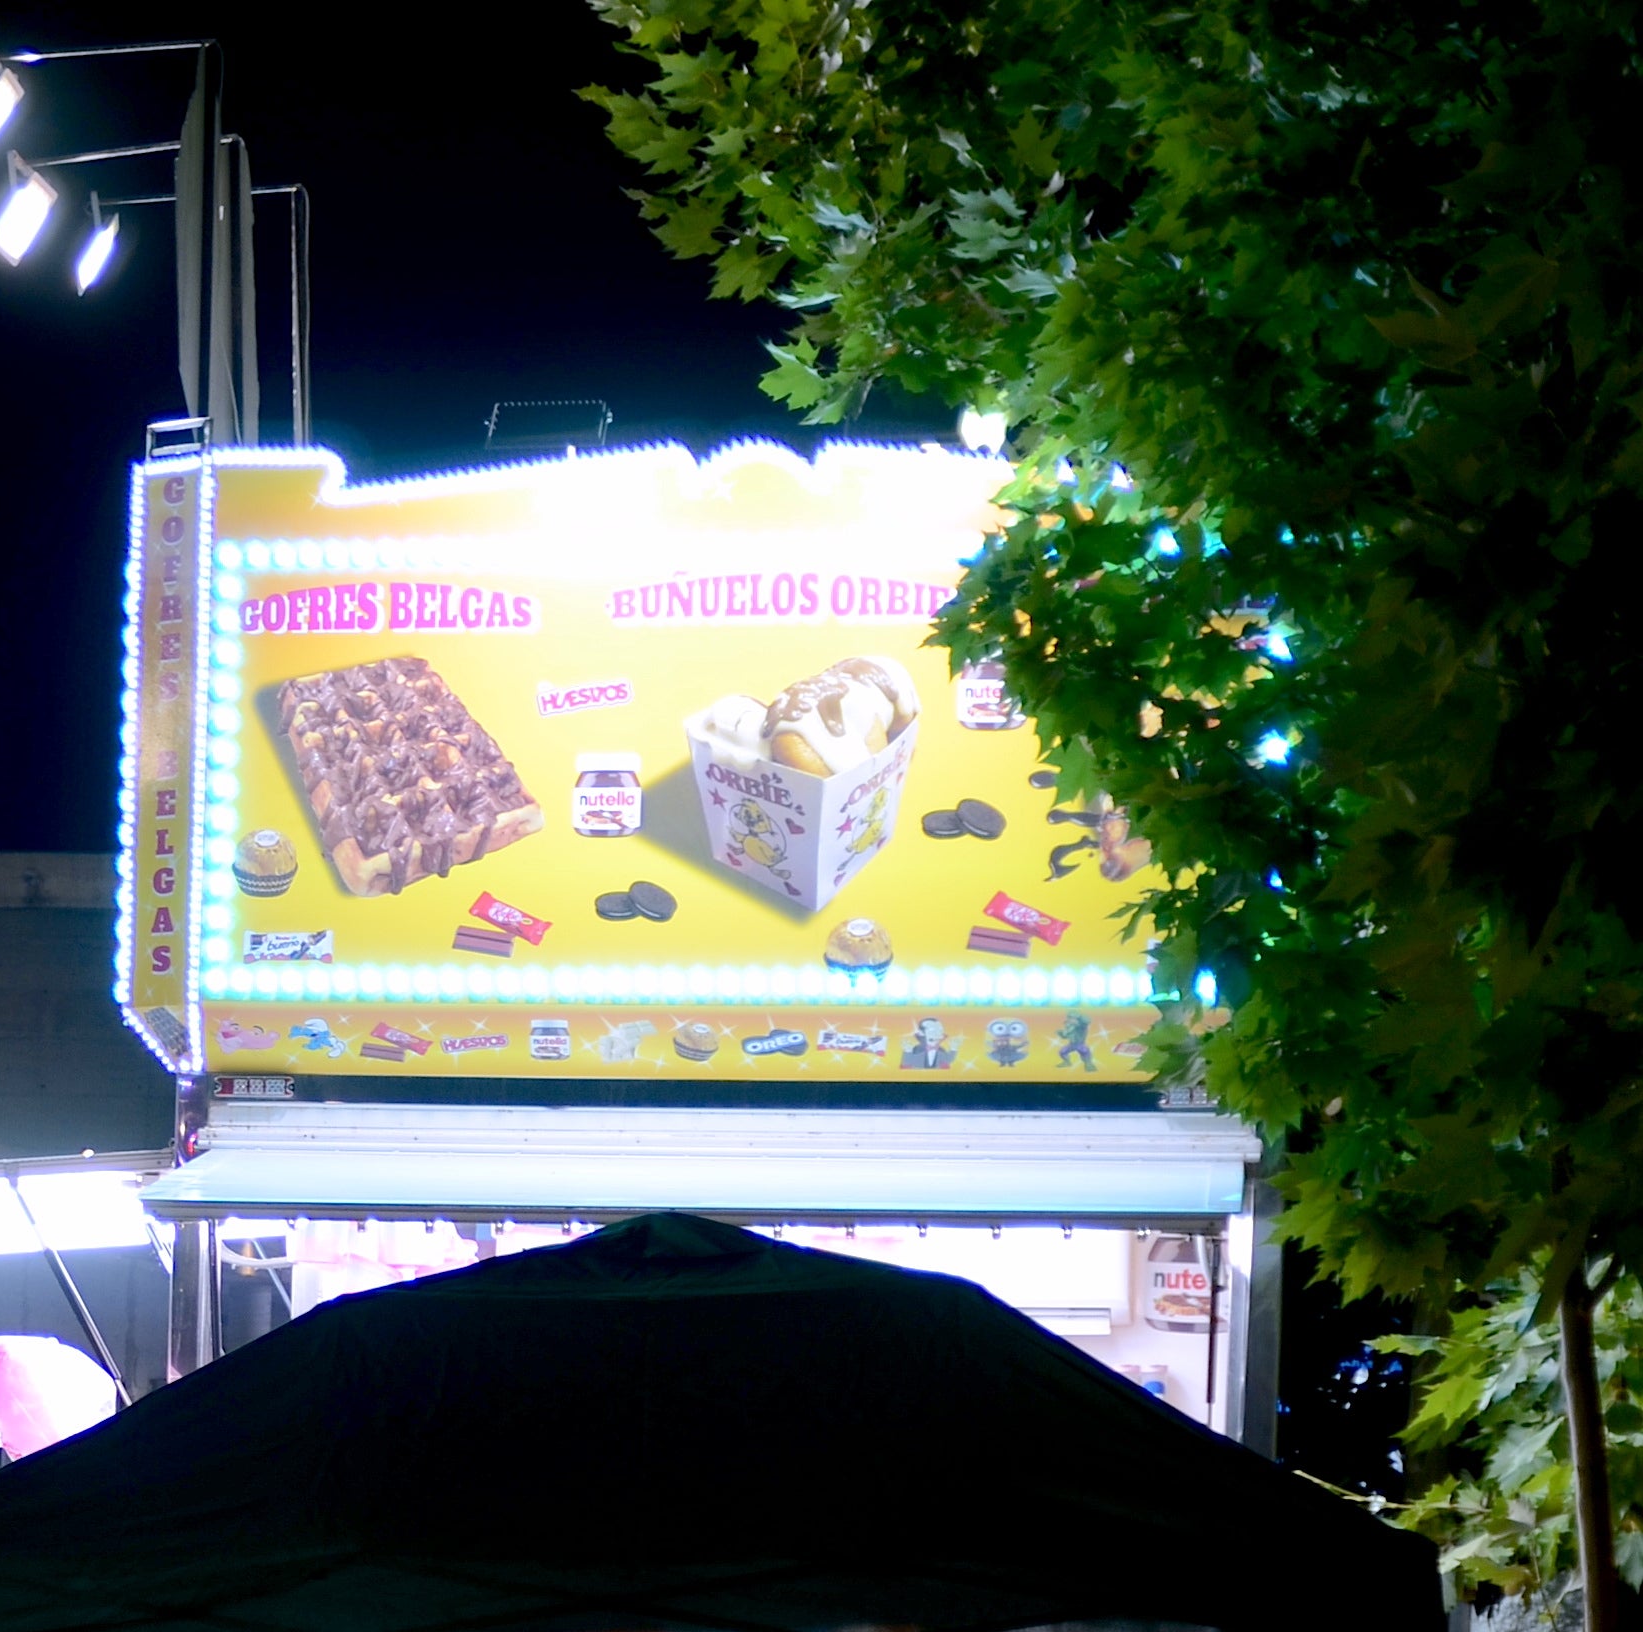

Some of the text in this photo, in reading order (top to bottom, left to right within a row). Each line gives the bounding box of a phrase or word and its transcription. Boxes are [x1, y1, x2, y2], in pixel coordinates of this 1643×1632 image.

[238, 582, 533, 633] GOFRES BELGAS
[611, 571, 819, 619] BUÑUELOS
[965, 685, 1002, 699] nute
[151, 476, 185, 974] GOFRES BELGAS
[579, 790, 635, 806] nutella
[708, 763, 793, 809] ORBIE
[747, 1033, 804, 1052] OREO
[1154, 1269, 1208, 1289] nute
